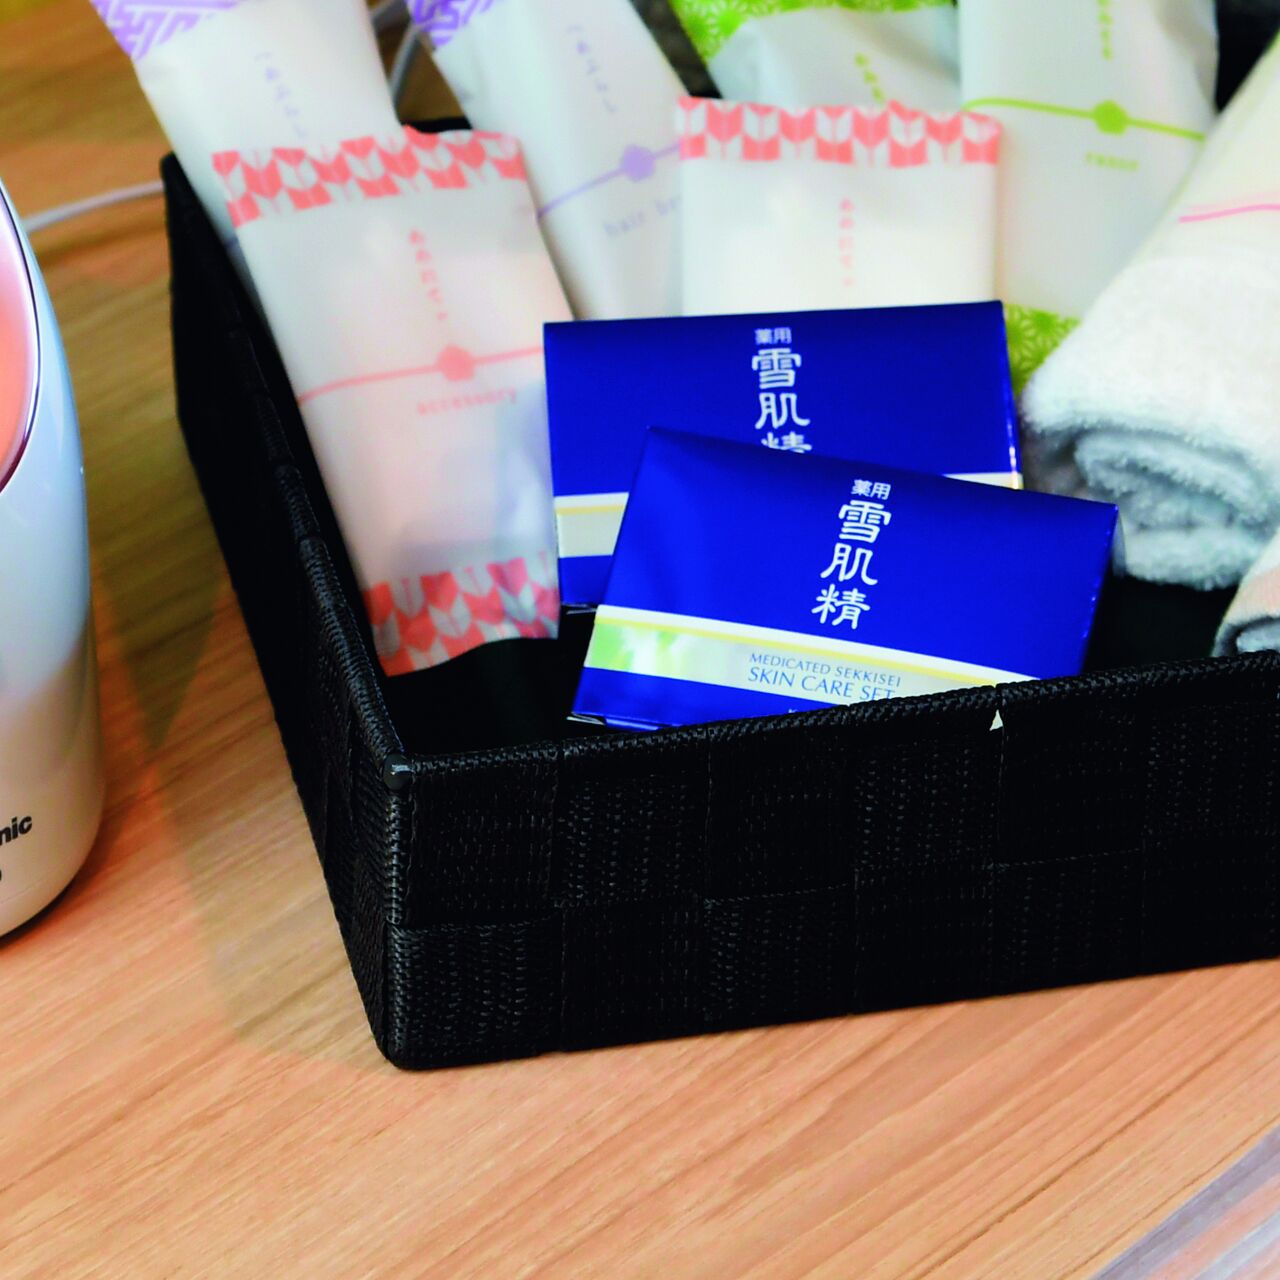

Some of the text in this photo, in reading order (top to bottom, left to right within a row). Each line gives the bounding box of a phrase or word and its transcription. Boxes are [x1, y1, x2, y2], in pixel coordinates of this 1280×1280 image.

[754, 327, 792, 345] 薬用
[851, 479, 892, 500] 薬用
[811, 499, 893, 631] 雪肌精
[748, 666, 796, 688] SKIN
[801, 675, 855, 698] CARE
[751, 652, 901, 687] MEDICATED SEKKISEI
